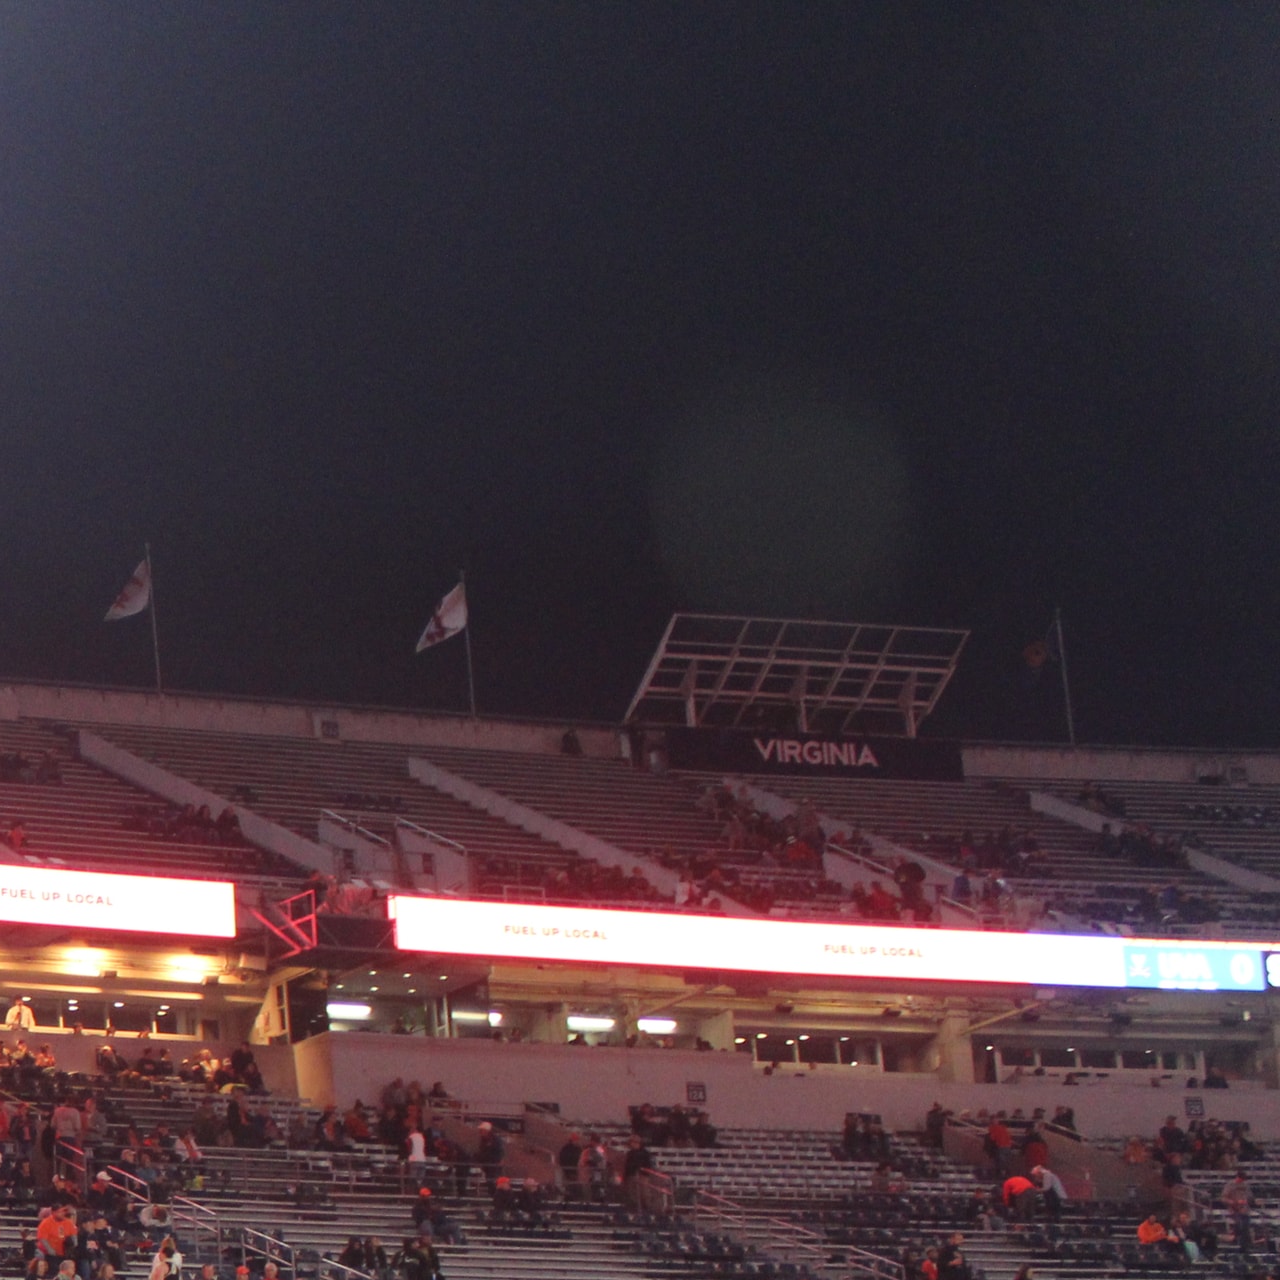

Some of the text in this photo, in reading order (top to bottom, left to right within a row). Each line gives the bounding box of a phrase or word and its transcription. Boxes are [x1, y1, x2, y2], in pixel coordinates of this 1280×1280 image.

[754, 738, 880, 767] VIRGINIA
[1, 887, 113, 906] FUEL UP LOCAL
[504, 925, 608, 941] FUEL UP LOCAL
